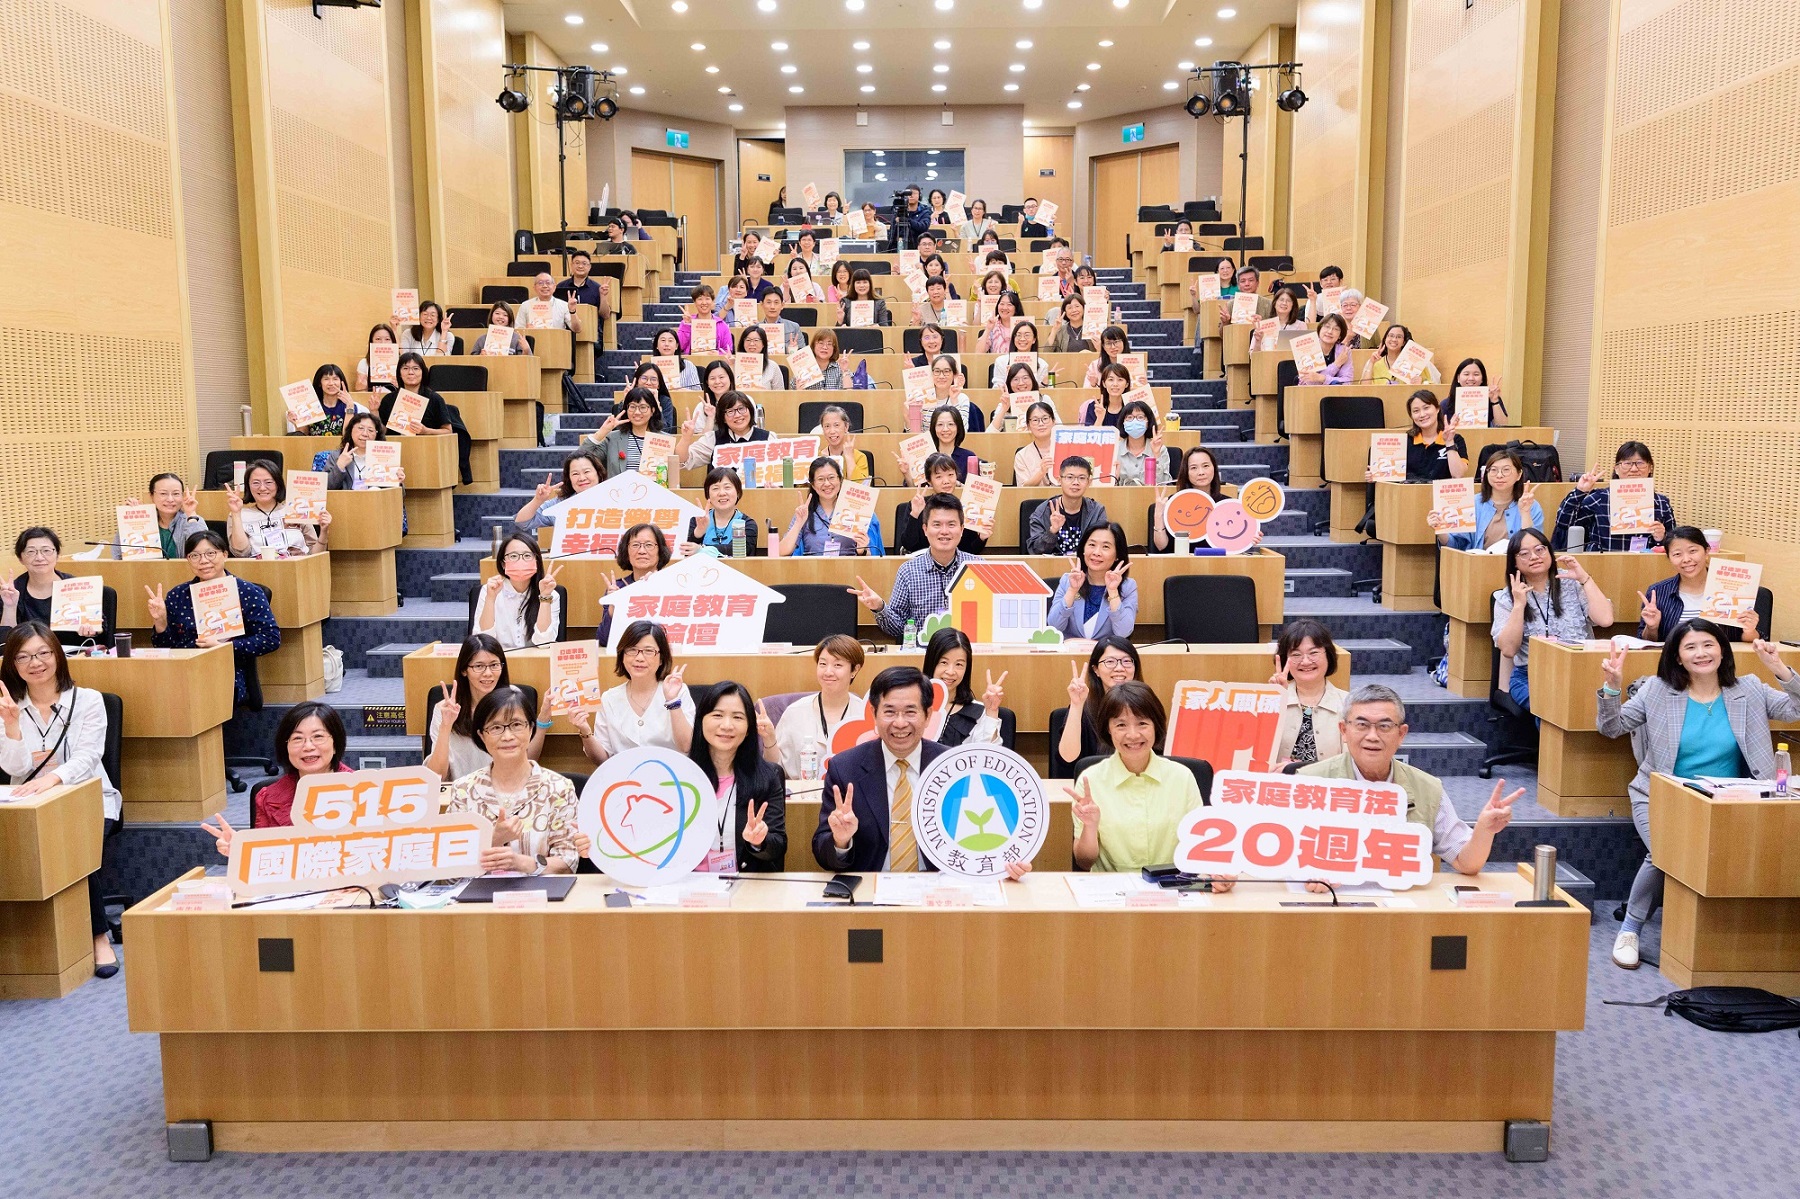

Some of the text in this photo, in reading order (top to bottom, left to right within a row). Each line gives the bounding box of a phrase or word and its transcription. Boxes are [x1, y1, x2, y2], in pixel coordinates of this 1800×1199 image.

[716, 439, 816, 466] 家庭教育
[566, 508, 680, 529] 打造樂學
[561, 533, 677, 554] 幸福
[627, 594, 758, 618] 家庭教育
[376, 711, 406, 719] 注意高低
[1182, 687, 1281, 715] 家人關係
[307, 779, 428, 831] 515
[922, 755, 1038, 850] MINISTRY OF EDUCATION
[1221, 778, 1398, 816] 家庭教育法
[242, 825, 481, 885] 國際家庭日
[948, 843, 1021, 874] 教育部
[1186, 818, 1420, 877] 20週年
